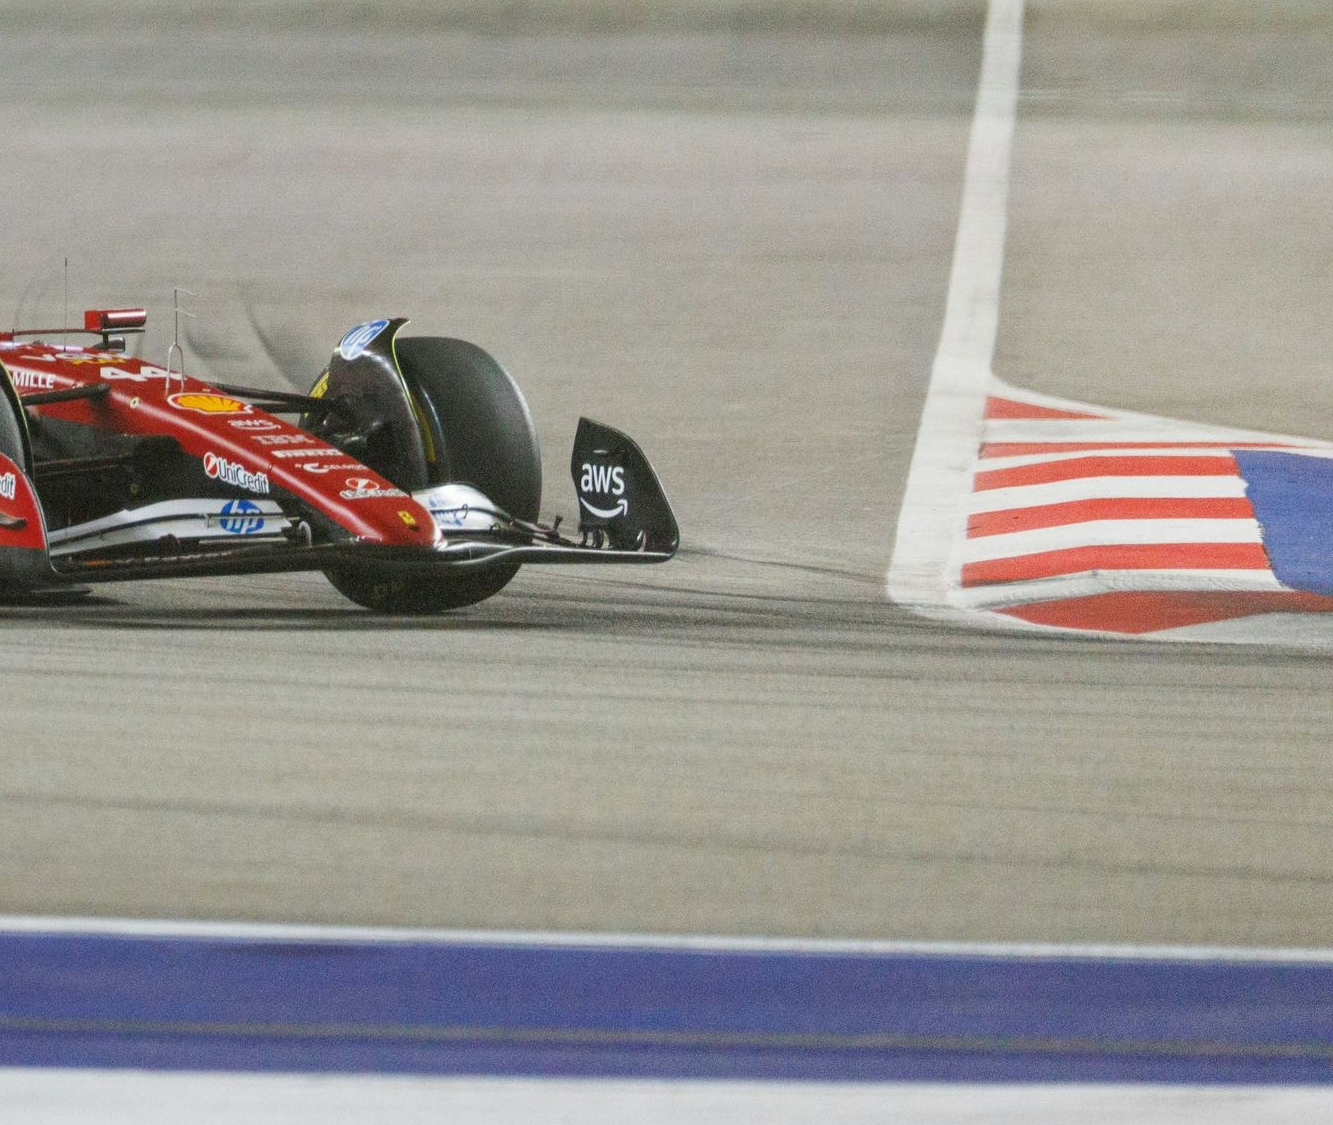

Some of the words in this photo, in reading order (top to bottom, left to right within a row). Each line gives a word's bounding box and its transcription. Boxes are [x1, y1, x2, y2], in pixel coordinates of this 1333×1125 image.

[13, 370, 54, 389] MILLE
[100, 366, 187, 382] 44
[218, 458, 270, 494] UniCredit
[581, 462, 625, 495] aws
